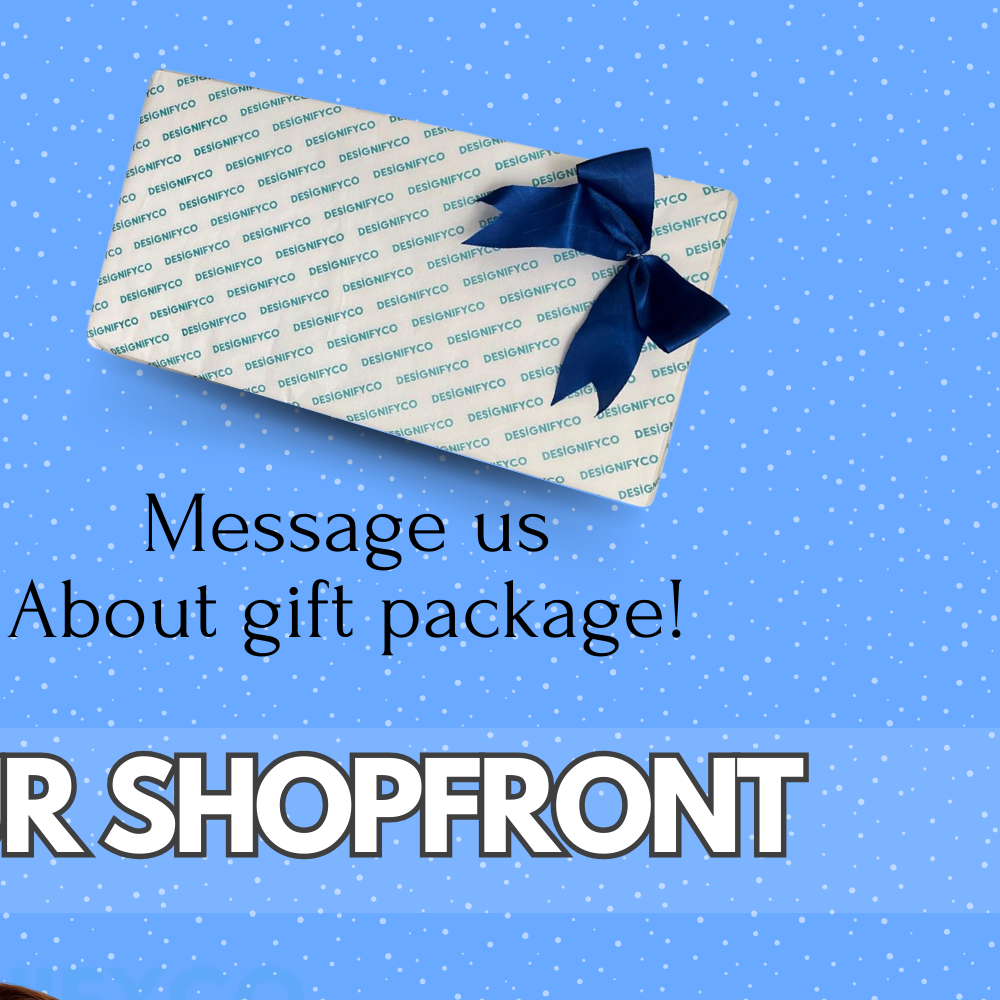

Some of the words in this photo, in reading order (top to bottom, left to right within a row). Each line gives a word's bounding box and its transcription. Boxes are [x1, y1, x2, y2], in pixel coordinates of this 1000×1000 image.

[139, 99, 197, 123] ESİGNIFYCO
[125, 152, 183, 178] ESİGNIFYCO
[112, 207, 167, 232] ESİGNIFYCO
[98, 261, 154, 286] ESİGNIFYCO
